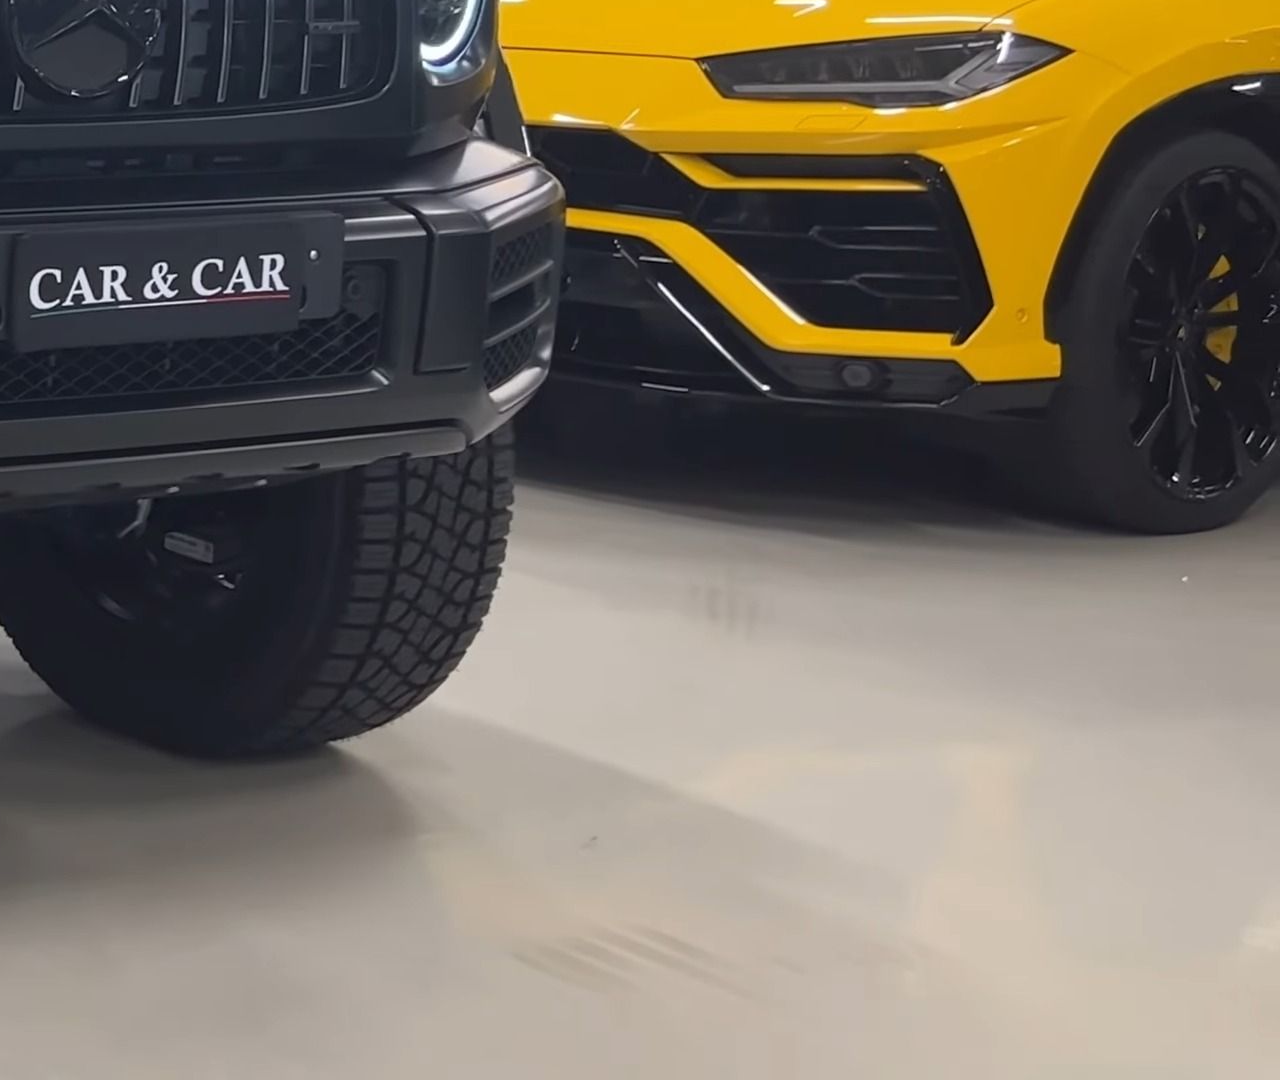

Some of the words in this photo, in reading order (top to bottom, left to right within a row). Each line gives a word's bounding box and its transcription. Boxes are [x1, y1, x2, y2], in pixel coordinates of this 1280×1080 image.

[29, 265, 131, 310] CAR
[143, 261, 179, 300] &
[191, 253, 289, 297] CAR
